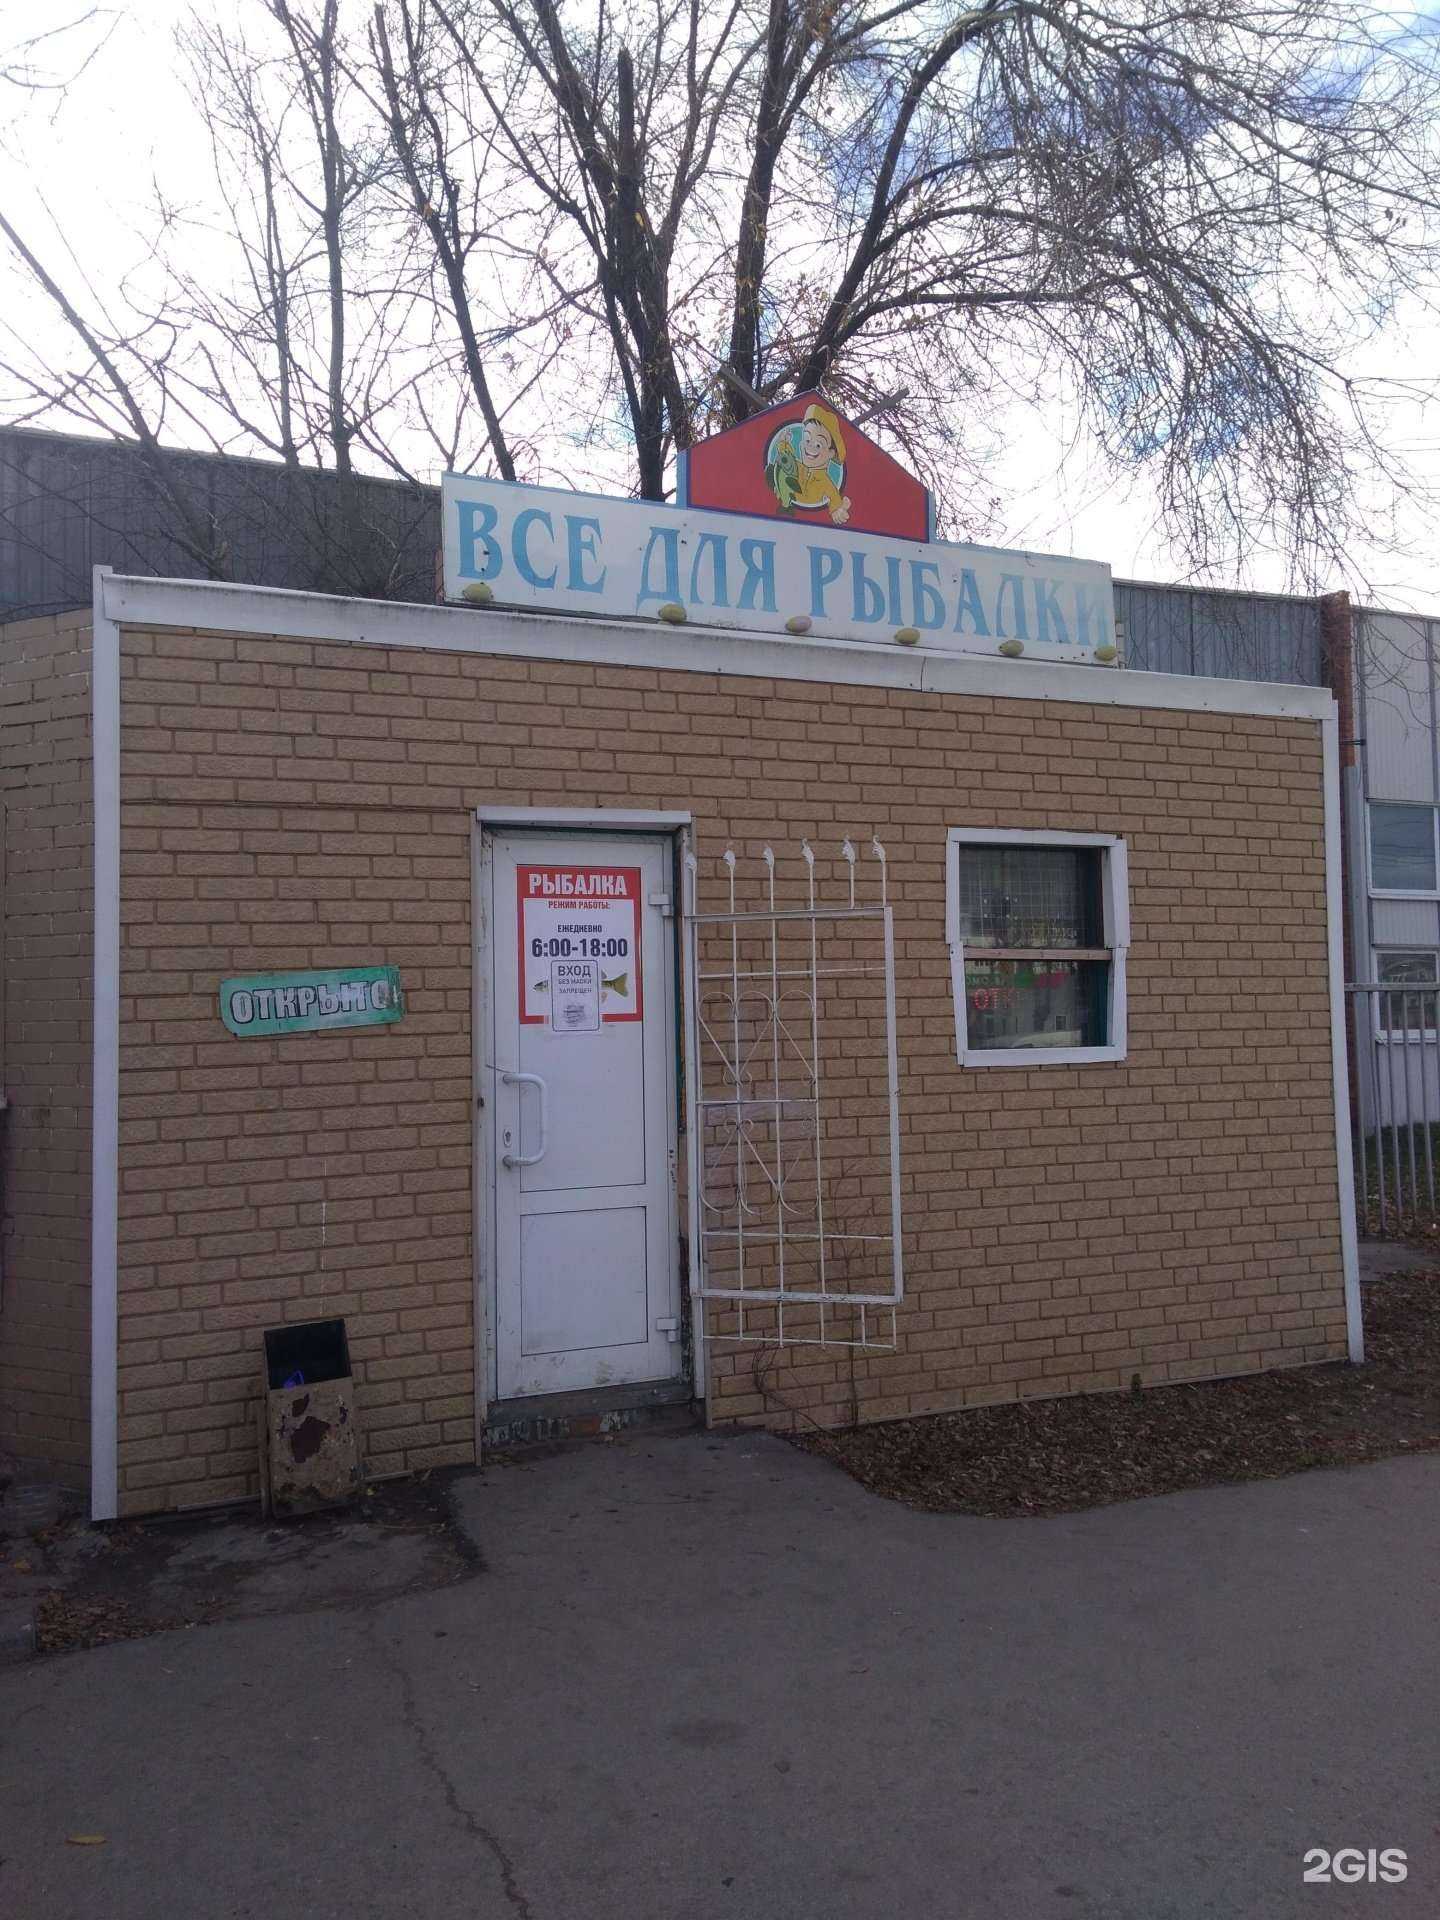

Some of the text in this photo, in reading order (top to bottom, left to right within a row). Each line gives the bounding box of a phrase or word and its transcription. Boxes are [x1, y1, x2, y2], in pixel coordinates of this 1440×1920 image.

[455, 499, 1112, 648] ВСЕ ДЛЯ РЫБАЛКИ
[528, 873, 627, 896] РЫБАЛКА
[548, 900, 577, 909] РЕЖИМ
[557, 924, 603, 934] ЕЖЕДНЕВНО
[531, 938, 628, 957] 6:00-18:00
[558, 965, 592, 978] ВХОД
[230, 980, 392, 1024] ОТКРЫТО
